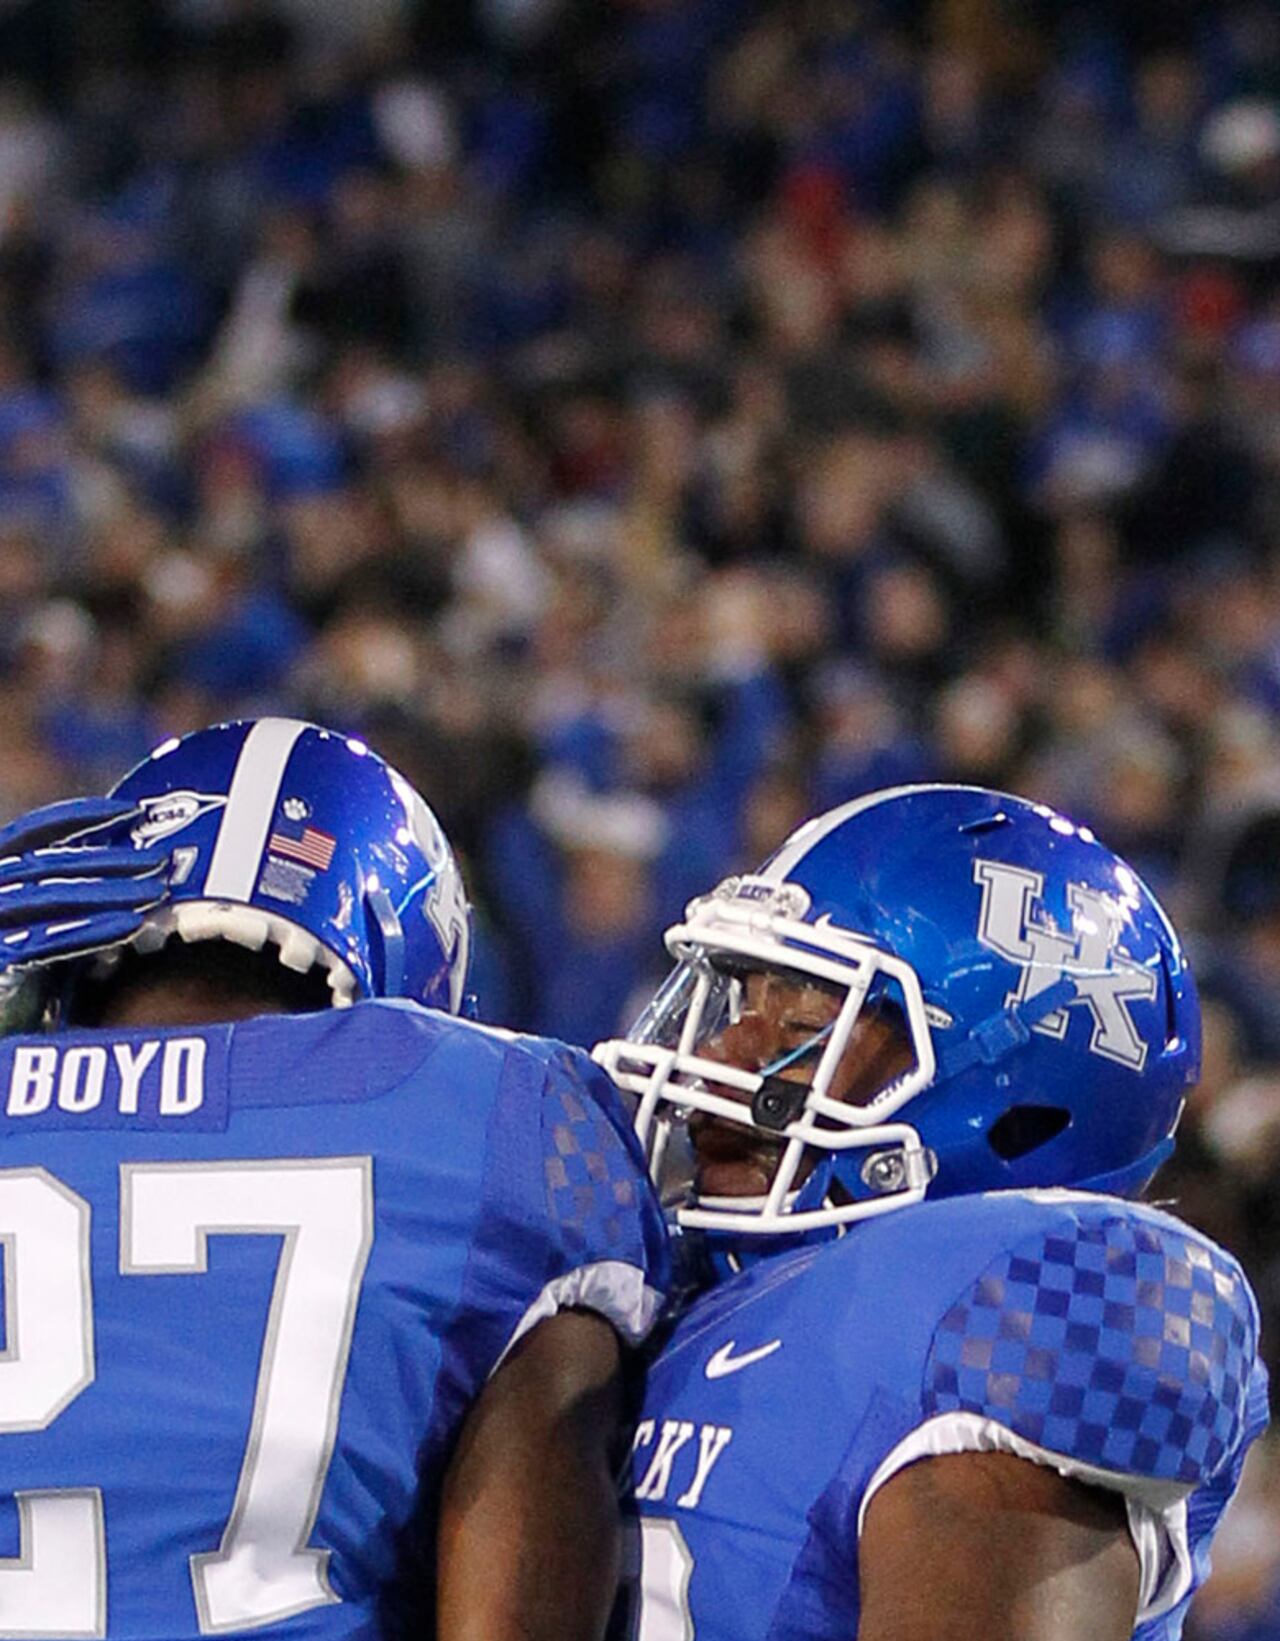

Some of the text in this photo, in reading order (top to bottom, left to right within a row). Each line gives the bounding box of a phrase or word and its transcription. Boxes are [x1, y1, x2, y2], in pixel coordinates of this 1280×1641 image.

[170, 846, 199, 885] 7
[972, 858, 1158, 1071] UK
[6, 1037, 207, 1116] BOYD
